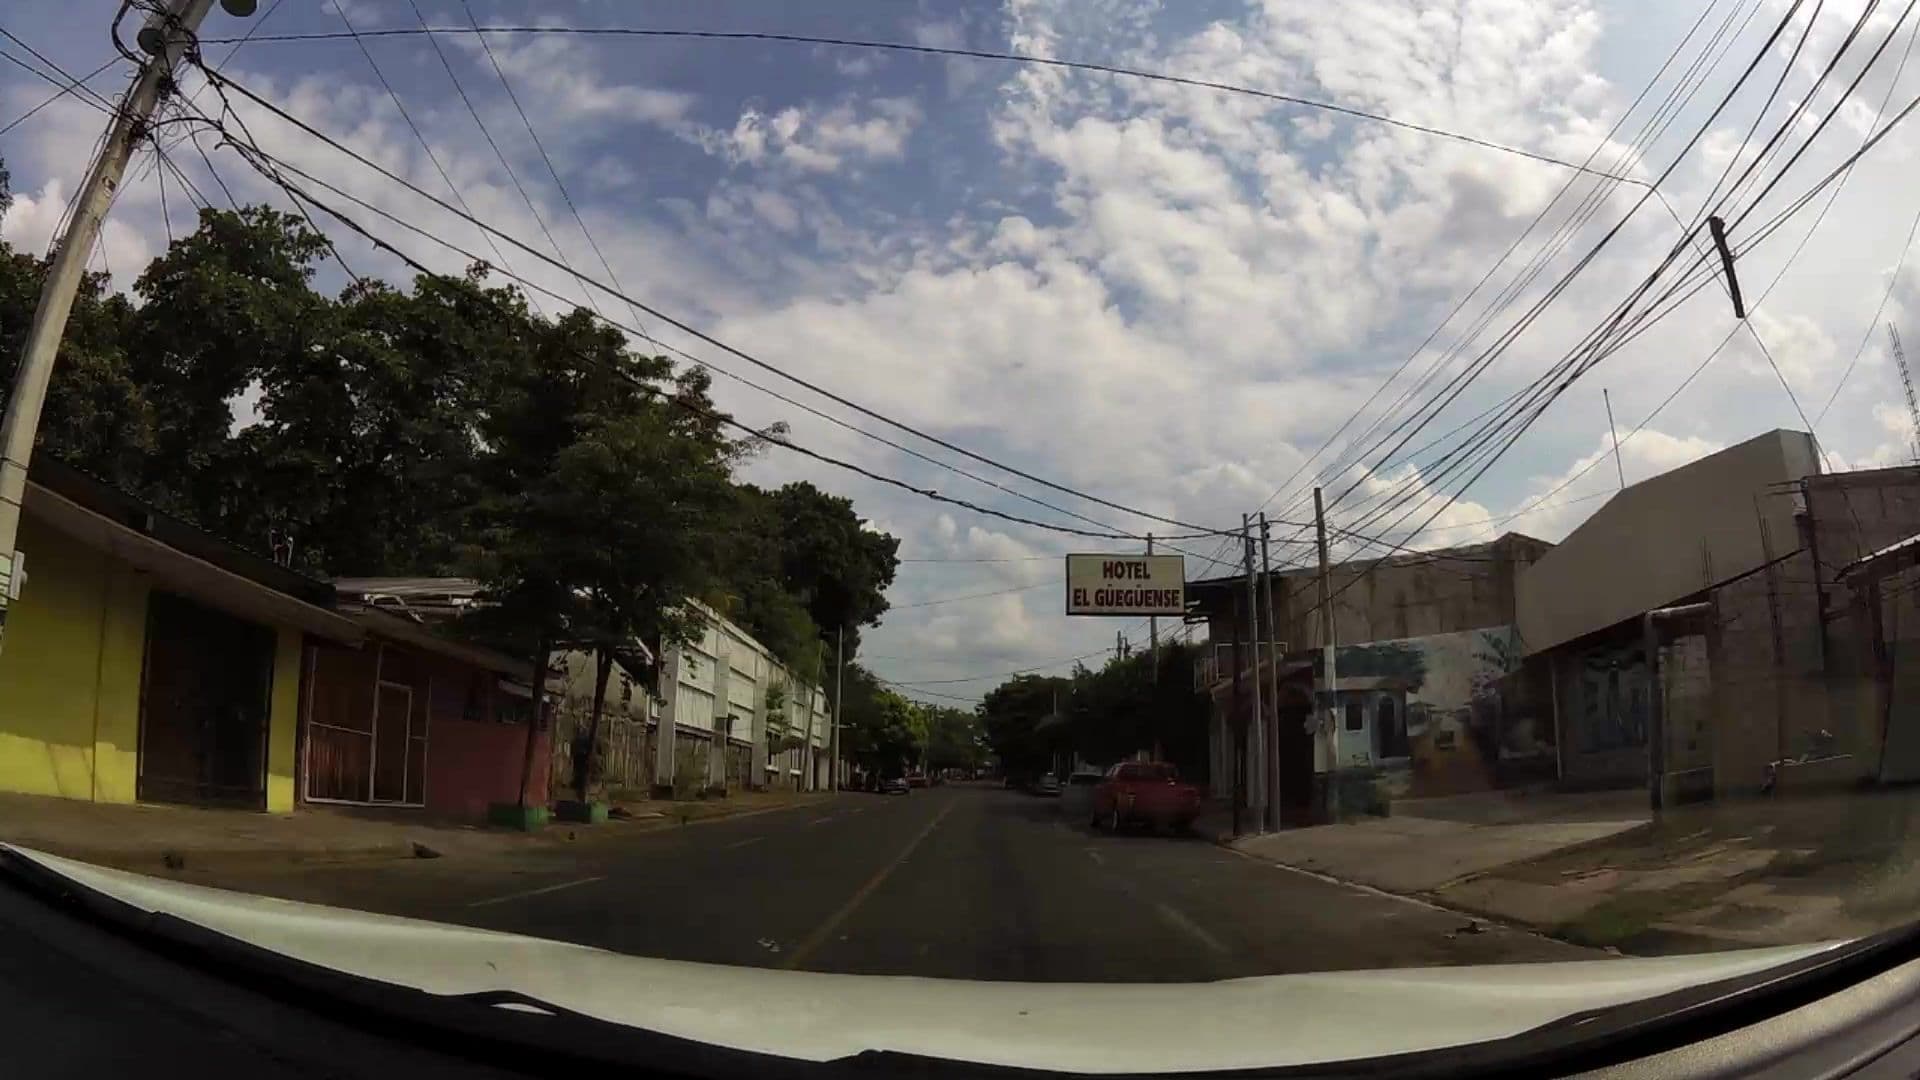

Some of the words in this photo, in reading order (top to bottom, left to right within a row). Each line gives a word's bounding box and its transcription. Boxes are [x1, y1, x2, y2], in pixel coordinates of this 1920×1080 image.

[1103, 561, 1151, 580] HOTEL
[1073, 588, 1090, 607] EL
[1094, 584, 1180, 608] GÜEGÜENSE
